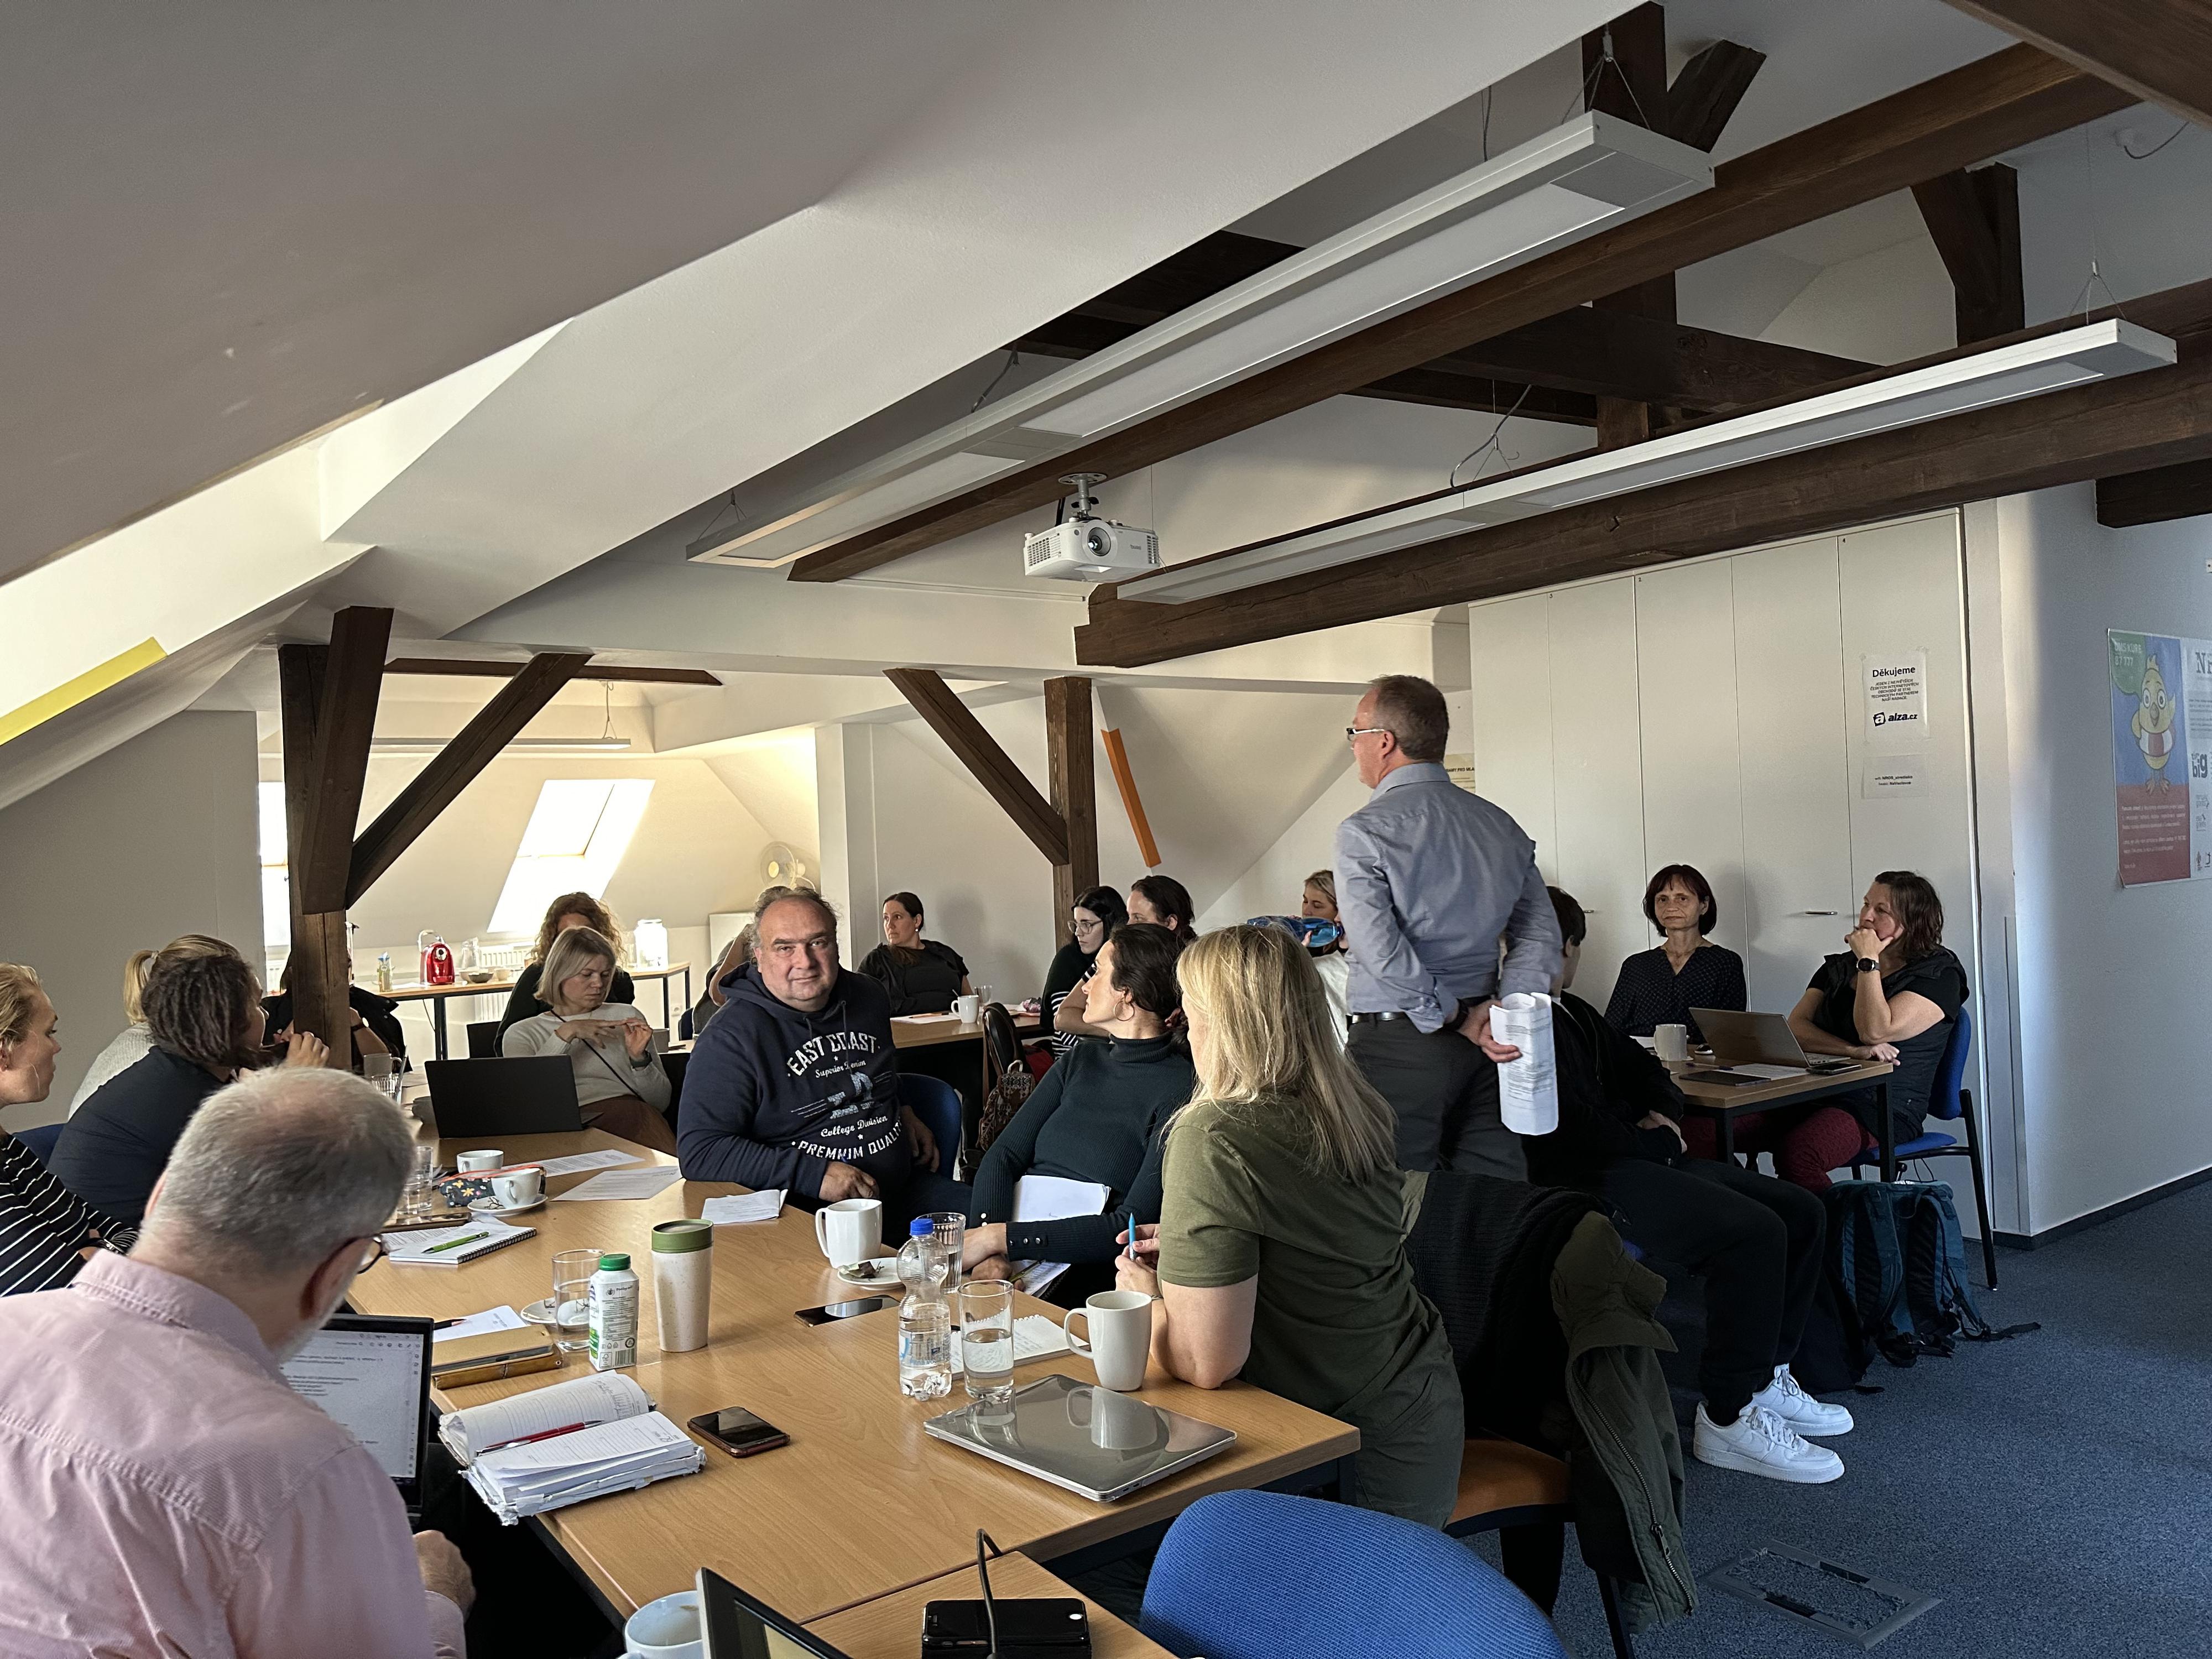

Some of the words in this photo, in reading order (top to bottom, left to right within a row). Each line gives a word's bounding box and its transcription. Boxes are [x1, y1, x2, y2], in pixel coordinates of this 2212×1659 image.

[1872, 667, 1916, 677] Děkujeme
[1888, 713, 1918, 721] alza.cz
[2192, 754, 2208, 778] big
[787, 1036, 825, 1076] EAST
[826, 1031, 877, 1053] COAST
[815, 1065, 844, 1078] Superior
[821, 1124, 855, 1138] College
[857, 1115, 888, 1130] Division
[868, 1117, 901, 1155] QUALIT
